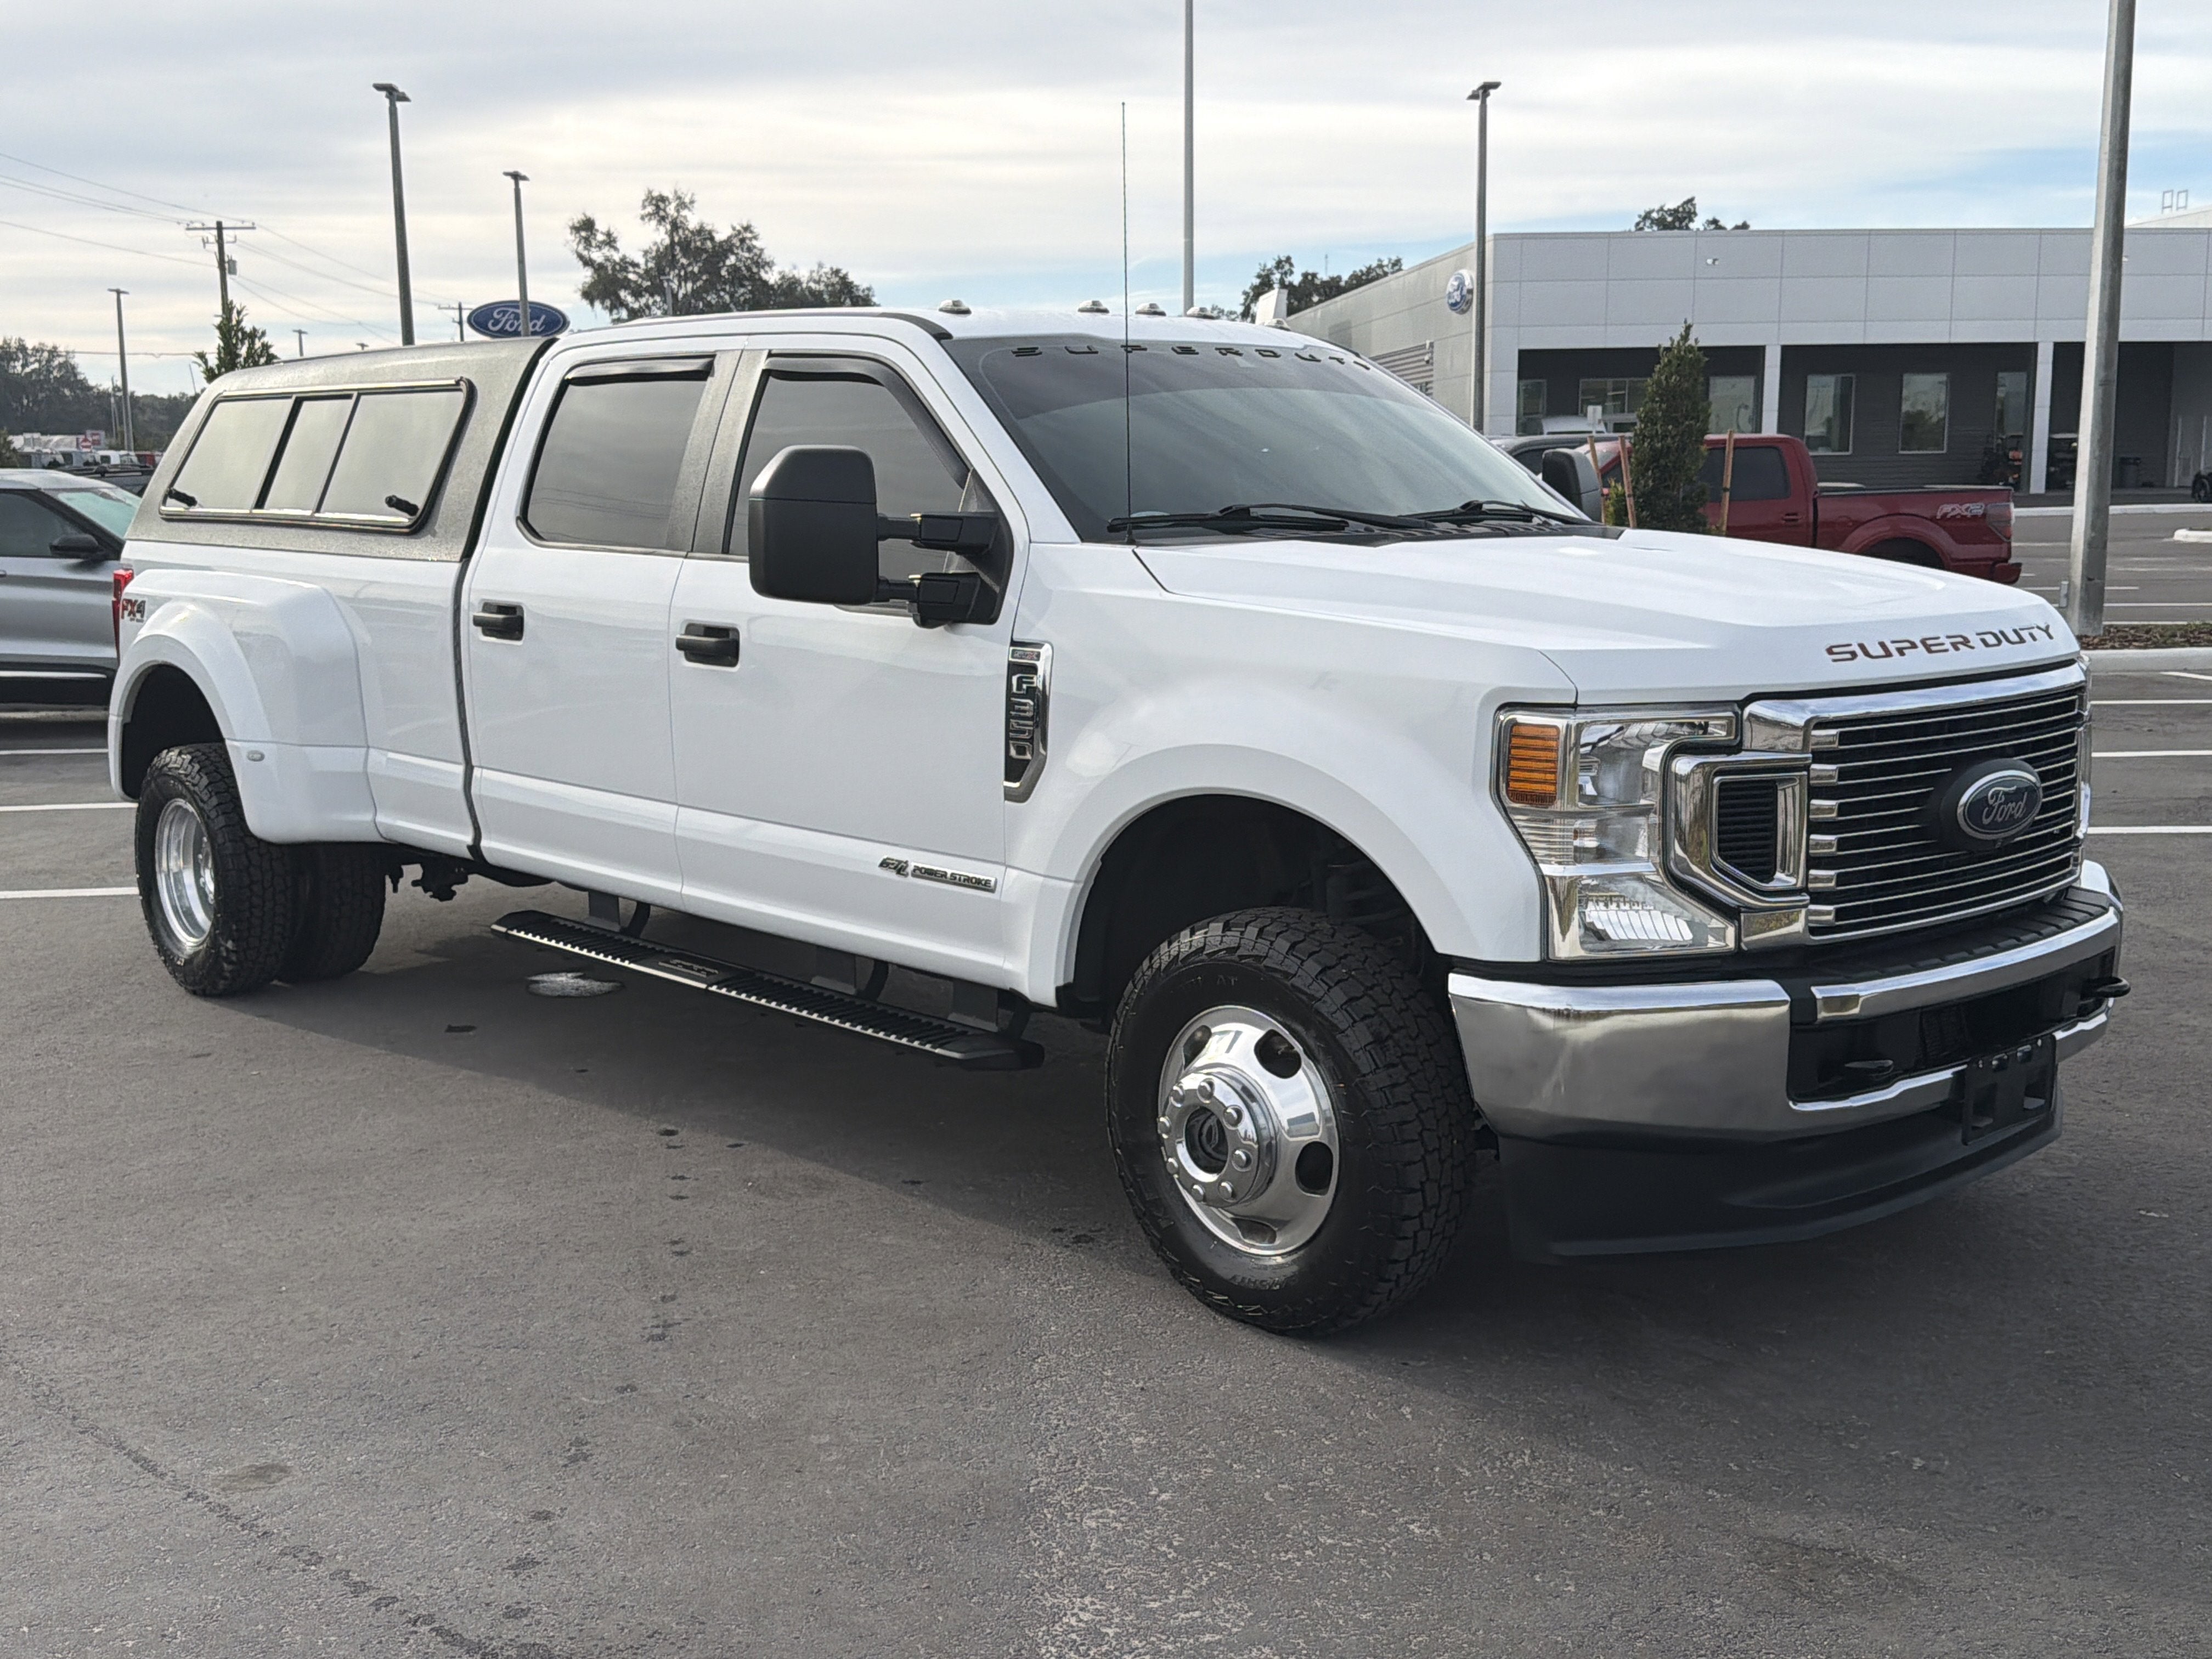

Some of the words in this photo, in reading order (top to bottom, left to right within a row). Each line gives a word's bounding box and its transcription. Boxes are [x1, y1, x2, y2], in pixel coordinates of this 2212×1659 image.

[487, 307, 546, 332] Fod
[121, 598, 146, 620] FX4
[1982, 785, 2028, 825] Ford
[912, 865, 947, 879] POWER
[950, 872, 992, 888] STROKE
